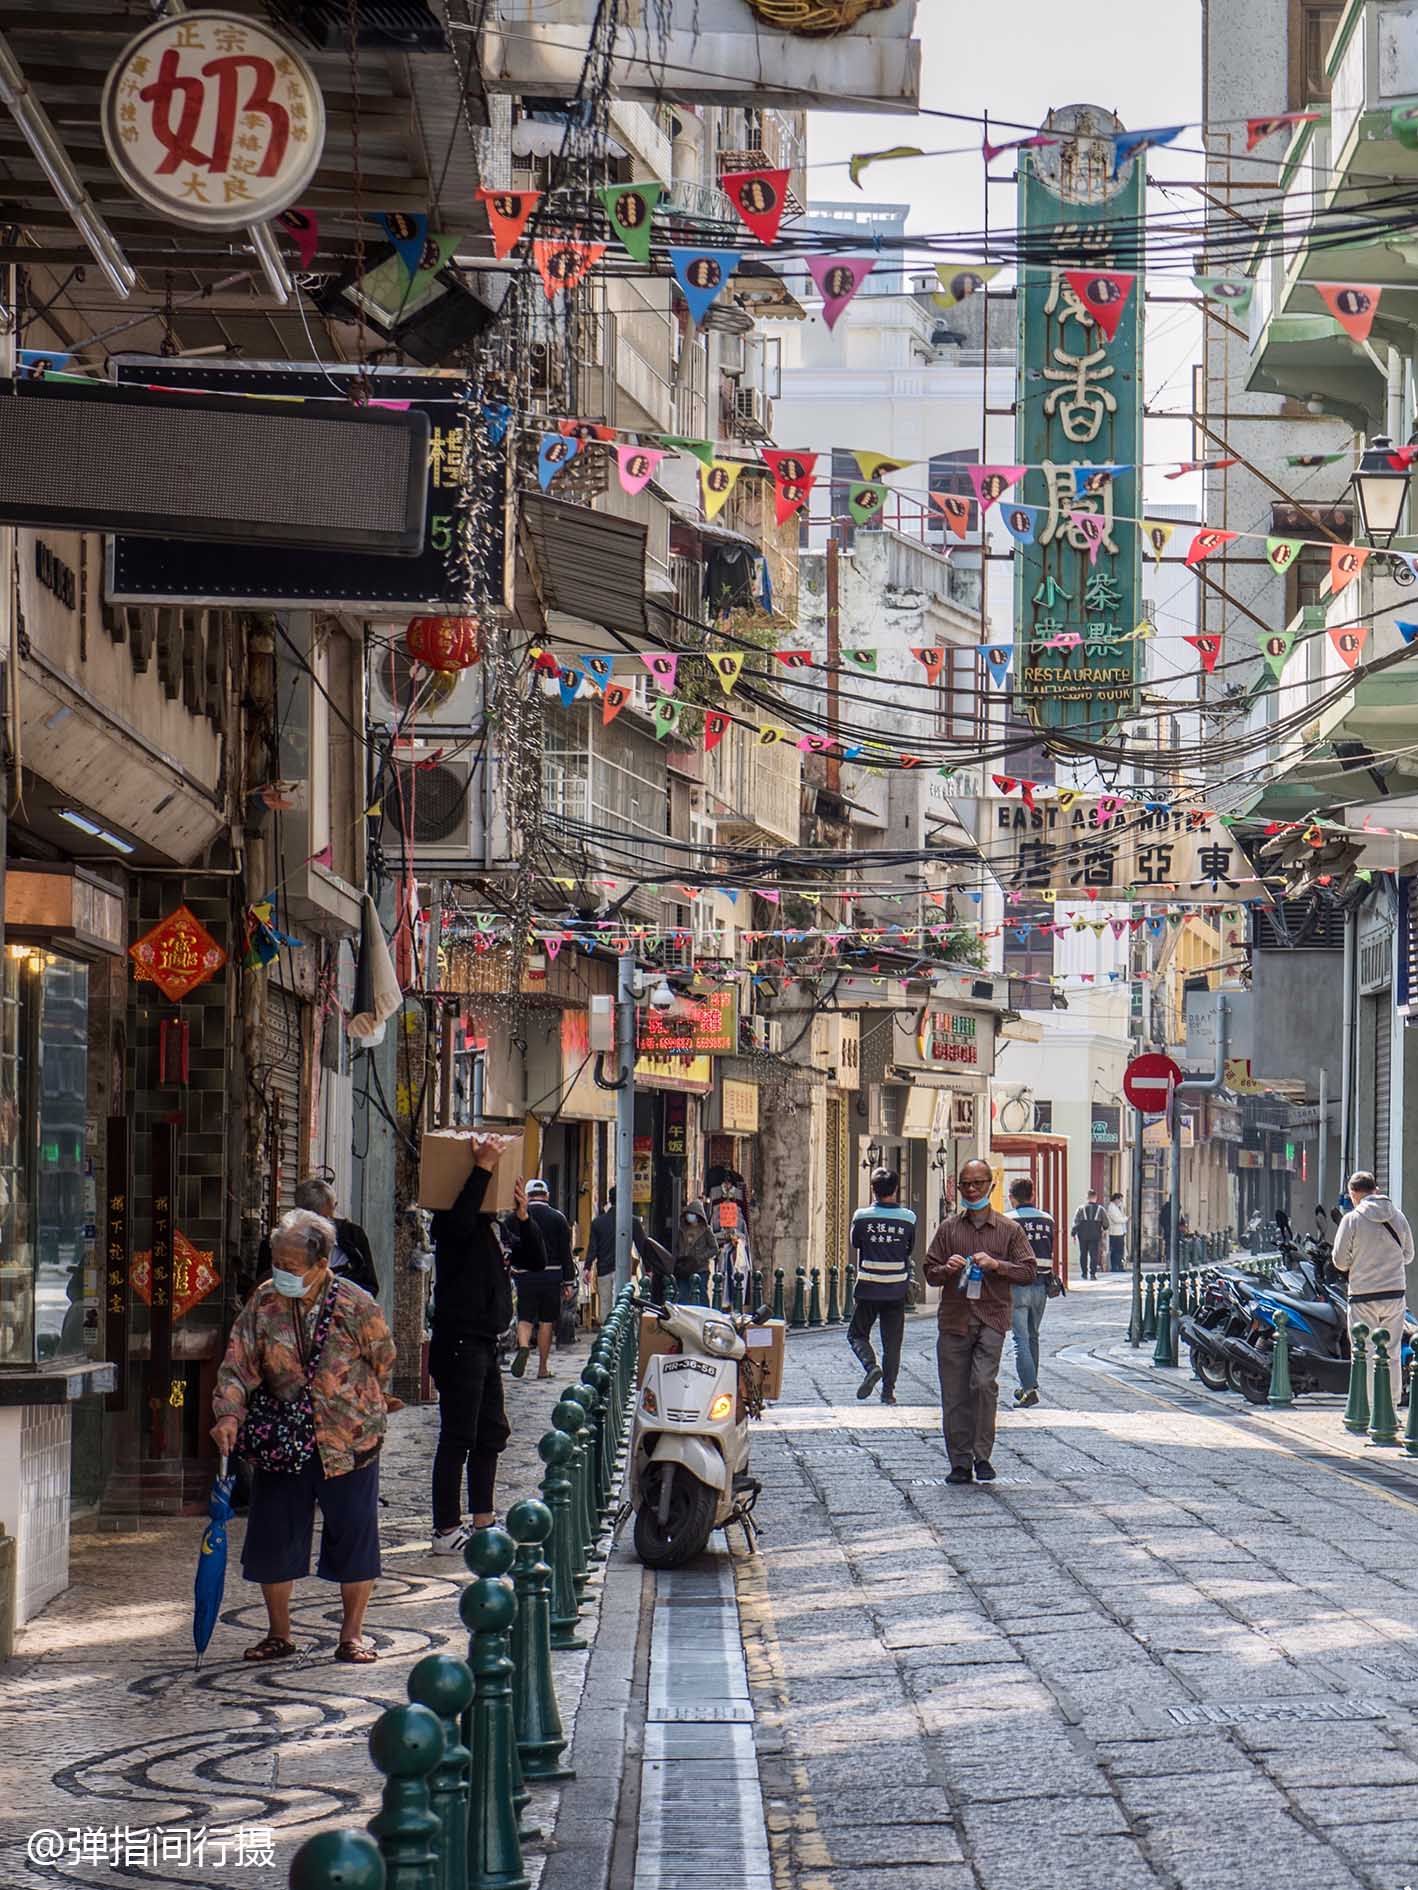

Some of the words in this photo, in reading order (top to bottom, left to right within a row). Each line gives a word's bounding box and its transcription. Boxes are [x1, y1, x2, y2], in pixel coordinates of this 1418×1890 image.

[170, 23, 249, 52] 正宗
[140, 48, 290, 178] 奶
[177, 171, 256, 206] 大良
[1024, 667, 1130, 682] RESTAURANTE
[998, 806, 1059, 828] EAST
[1071, 810, 1127, 830] ASIA
[1139, 811, 1211, 833] HOTEL
